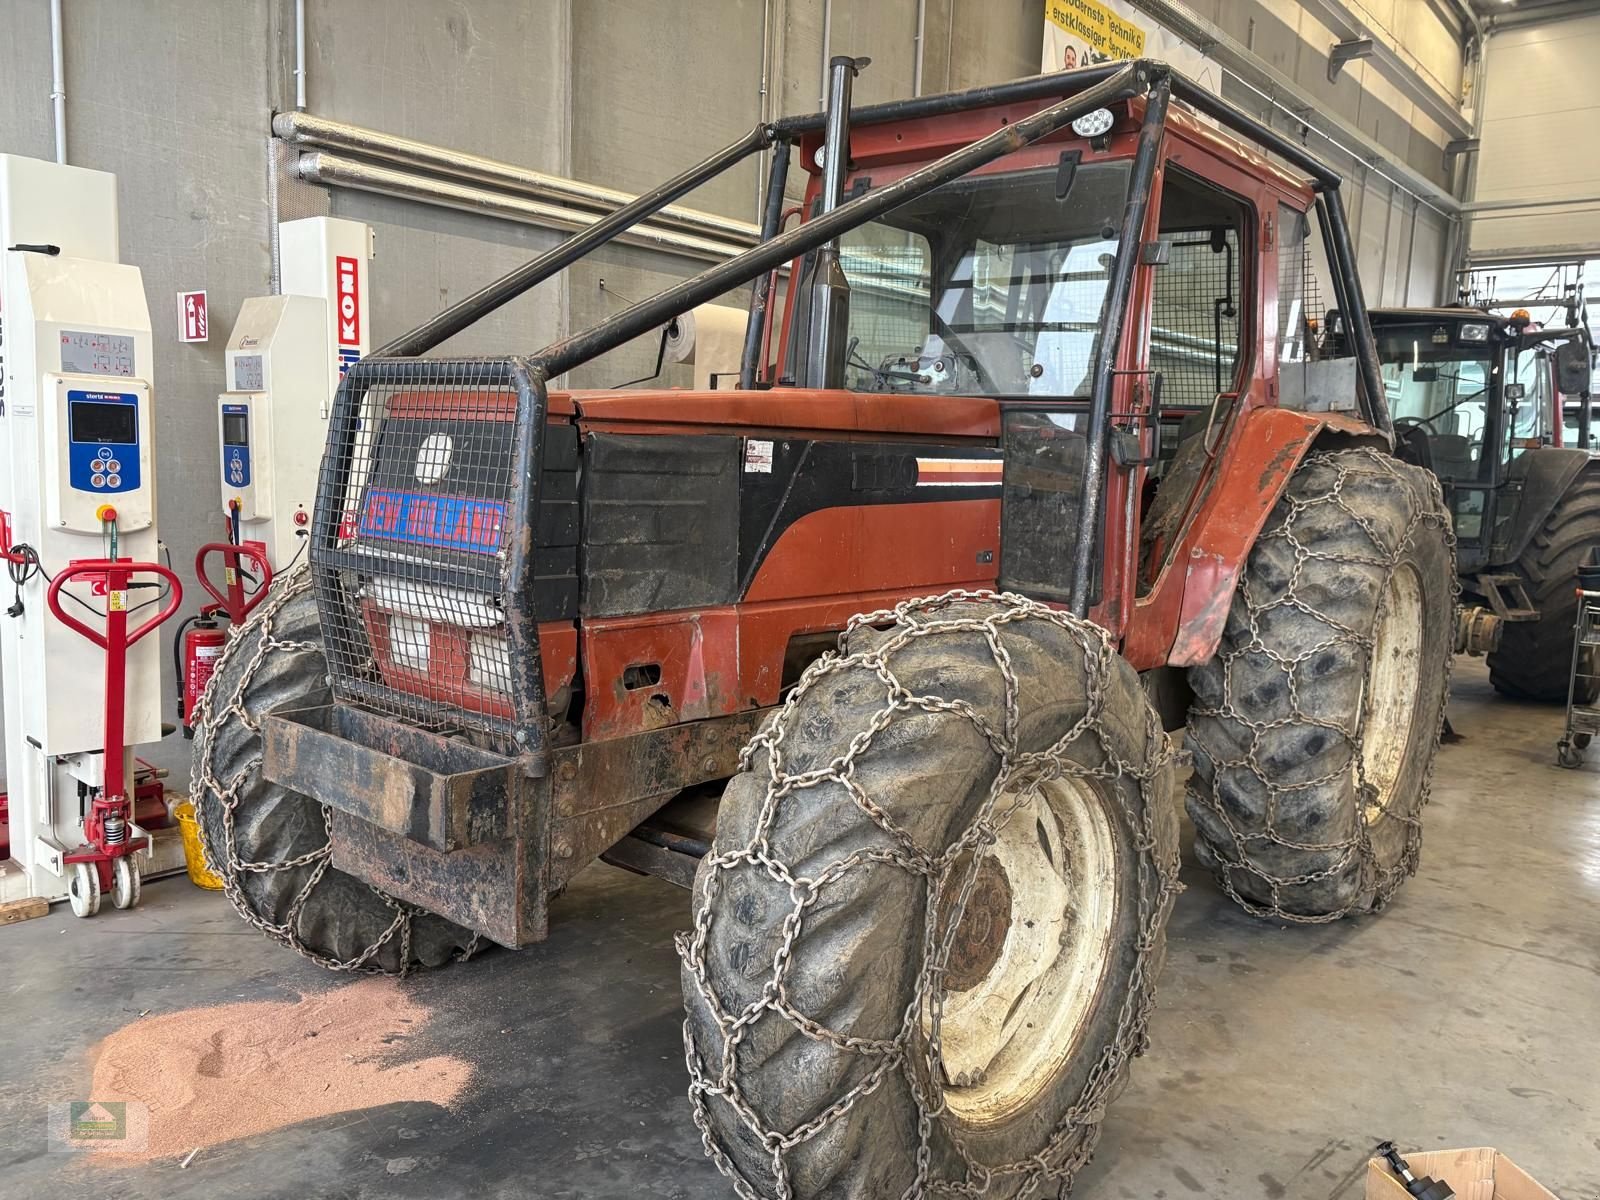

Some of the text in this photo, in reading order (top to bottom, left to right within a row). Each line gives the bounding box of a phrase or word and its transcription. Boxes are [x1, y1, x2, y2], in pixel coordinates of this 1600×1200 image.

[1053, 7, 1106, 47] erstklassiger
[1107, 13, 1136, 46] Technik
[1136, 34, 1142, 49] &
[340, 261, 356, 341] KONI
[363, 495, 501, 546] NEW HOLLAND
